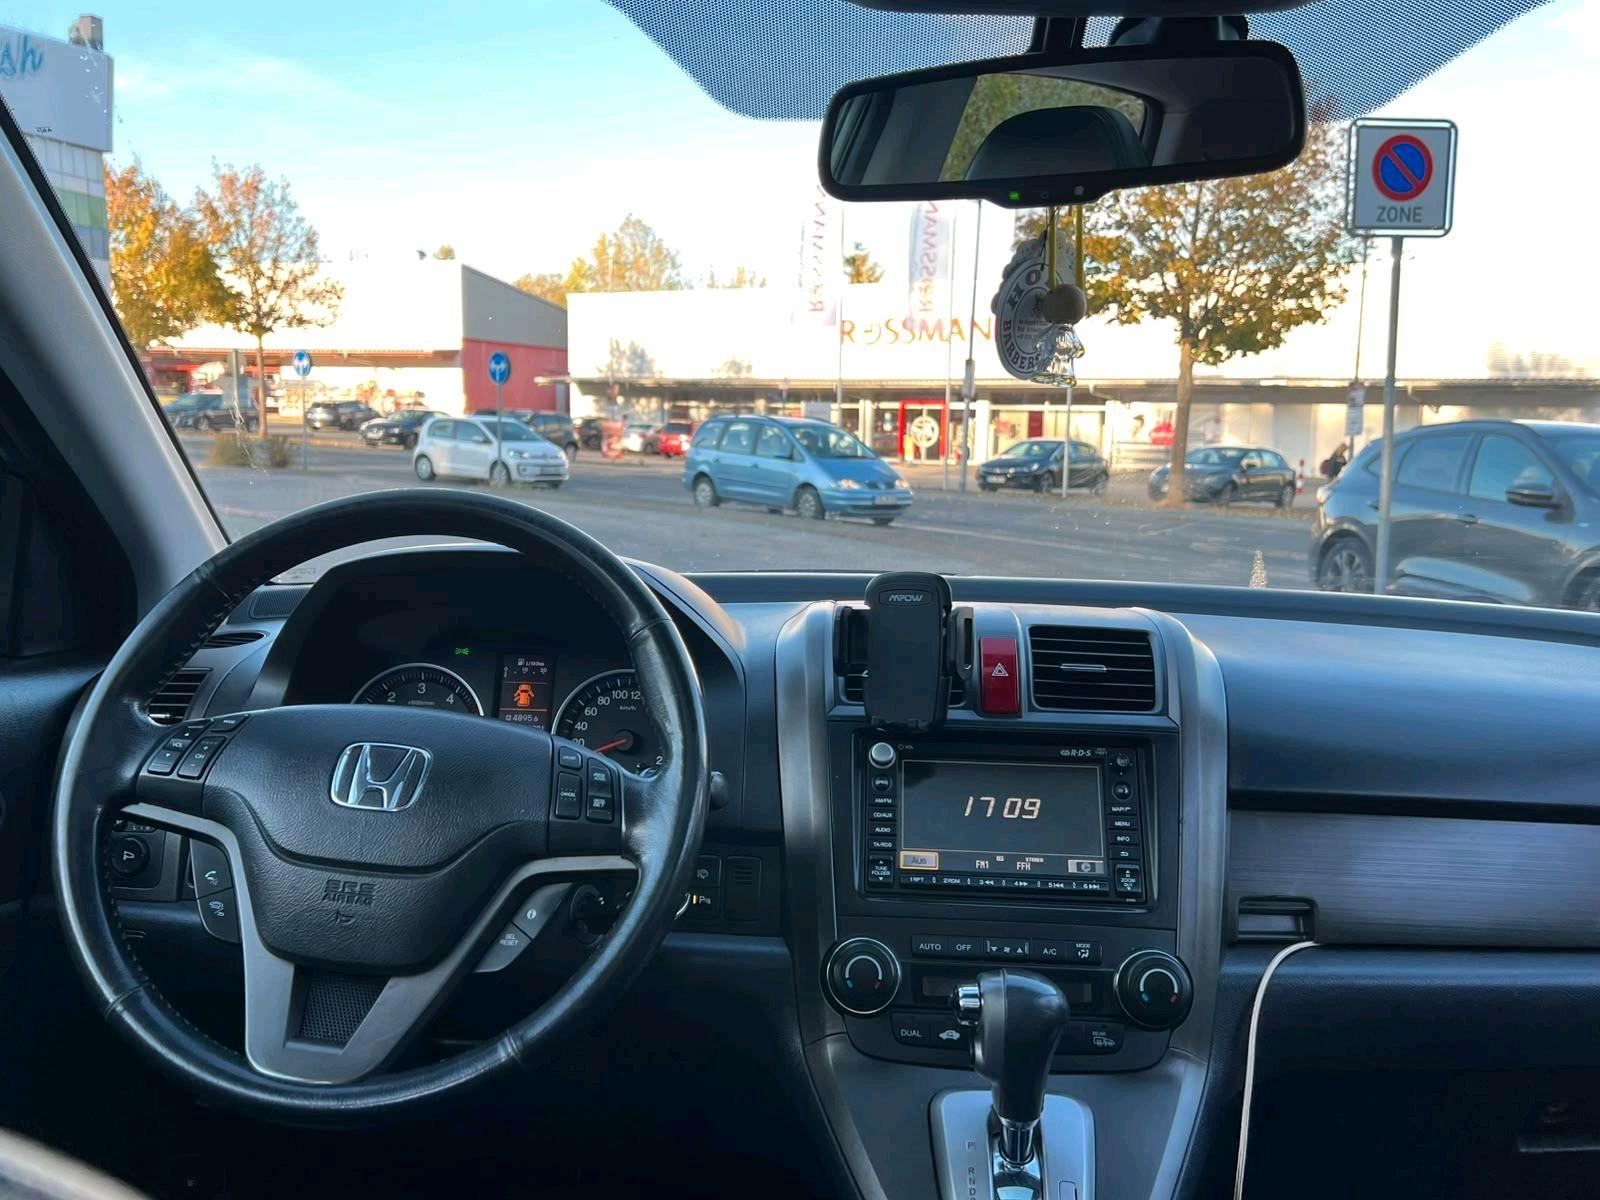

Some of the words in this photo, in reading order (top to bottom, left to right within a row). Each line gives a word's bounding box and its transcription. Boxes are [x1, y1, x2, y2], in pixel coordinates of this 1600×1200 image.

[1375, 205, 1424, 223] ZONE
[840, 317, 992, 345] ROSSMAN
[888, 594, 924, 602] MPOW
[387, 691, 396, 703] 2
[417, 683, 426, 694] 3
[446, 694, 455, 705] 4
[574, 721, 588, 731] 40
[584, 706, 598, 717] 60
[597, 695, 611, 706] 80
[611, 689, 629, 700] 100
[631, 690, 641, 701] 12
[975, 860, 989, 869] FM1
[1016, 862, 1031, 870] FFH
[918, 943, 942, 951] AUTO
[1042, 948, 1058, 956] A/C
[900, 1029, 922, 1038] DUAL
[968, 1166, 975, 1175] R
[969, 1178, 976, 1186] N
[969, 1188, 976, 1196] D
